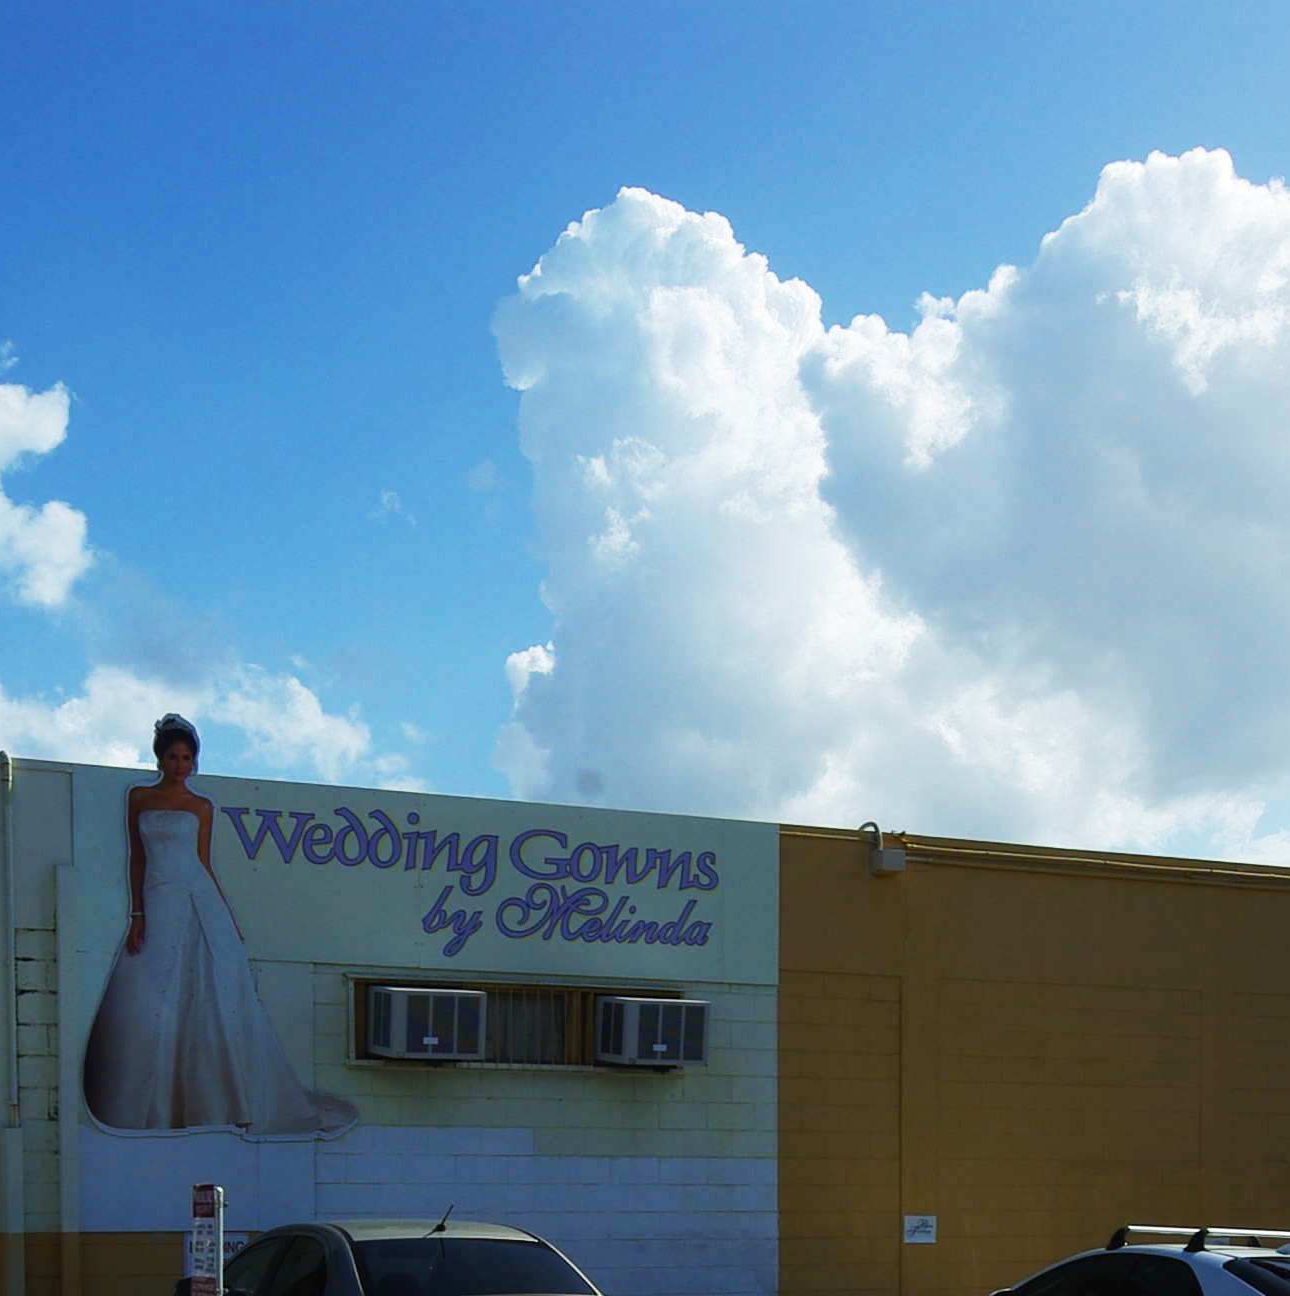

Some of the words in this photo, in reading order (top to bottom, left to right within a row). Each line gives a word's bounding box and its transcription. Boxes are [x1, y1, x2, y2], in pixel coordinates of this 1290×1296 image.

[221, 806, 500, 895] Wedding
[510, 829, 720, 890] Gowns
[422, 886, 483, 957] by
[496, 883, 713, 946] Melinda
